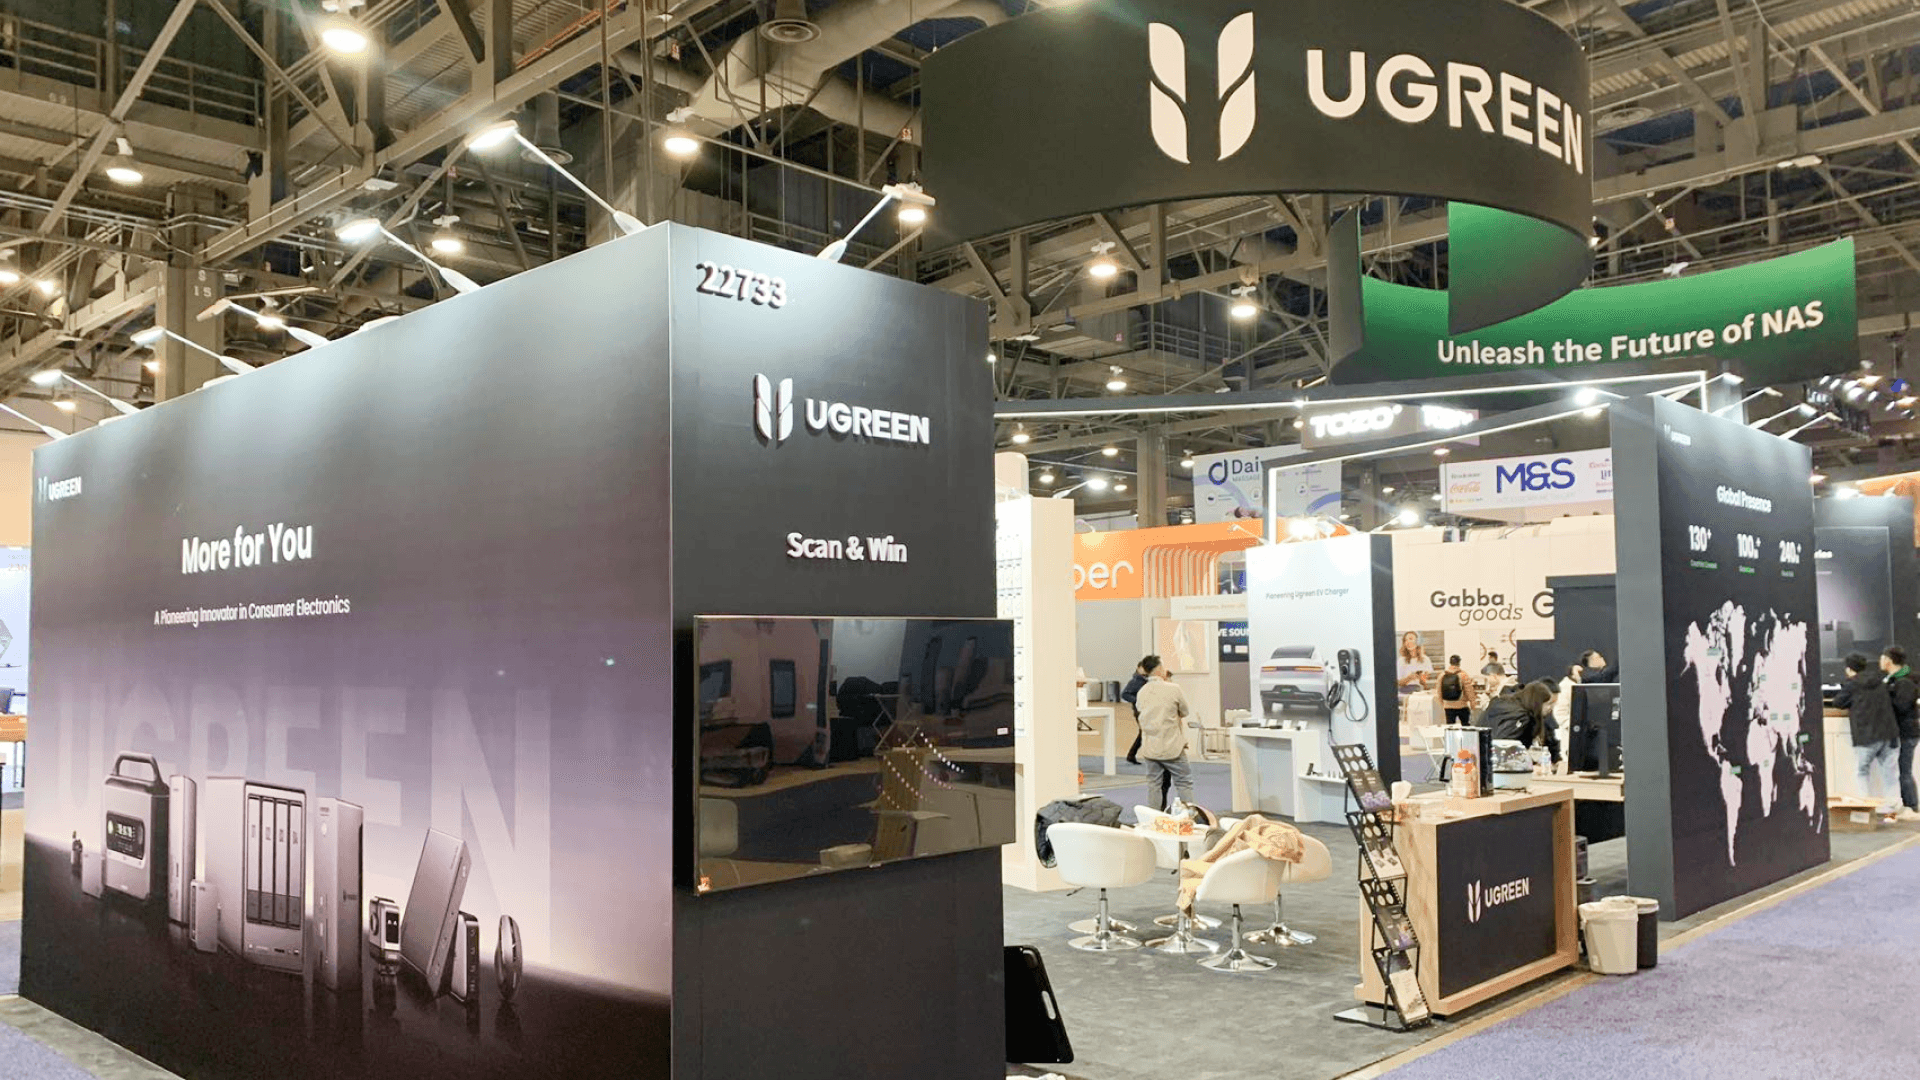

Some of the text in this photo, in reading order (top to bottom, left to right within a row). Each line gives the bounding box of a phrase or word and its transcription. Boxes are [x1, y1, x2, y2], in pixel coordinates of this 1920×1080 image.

[1306, 48, 1584, 174] UGREEN
[696, 260, 787, 309] 22733
[1437, 300, 1824, 367] Unleash the Future of NAS
[805, 398, 930, 444] UGREEN
[1310, 406, 1394, 438] TOZO
[48, 477, 82, 501] UGREEN
[1496, 458, 1575, 493] M&S
[1716, 485, 1772, 513] Global Presence
[181, 522, 313, 574] More for You
[787, 532, 907, 562] Scan & Win
[154, 594, 350, 629] A Pioneering Innovator in Consumer Electronics
[1430, 588, 1505, 608] Gabba
[1459, 602, 1524, 627] goods
[1485, 877, 1530, 908] UGREEN
